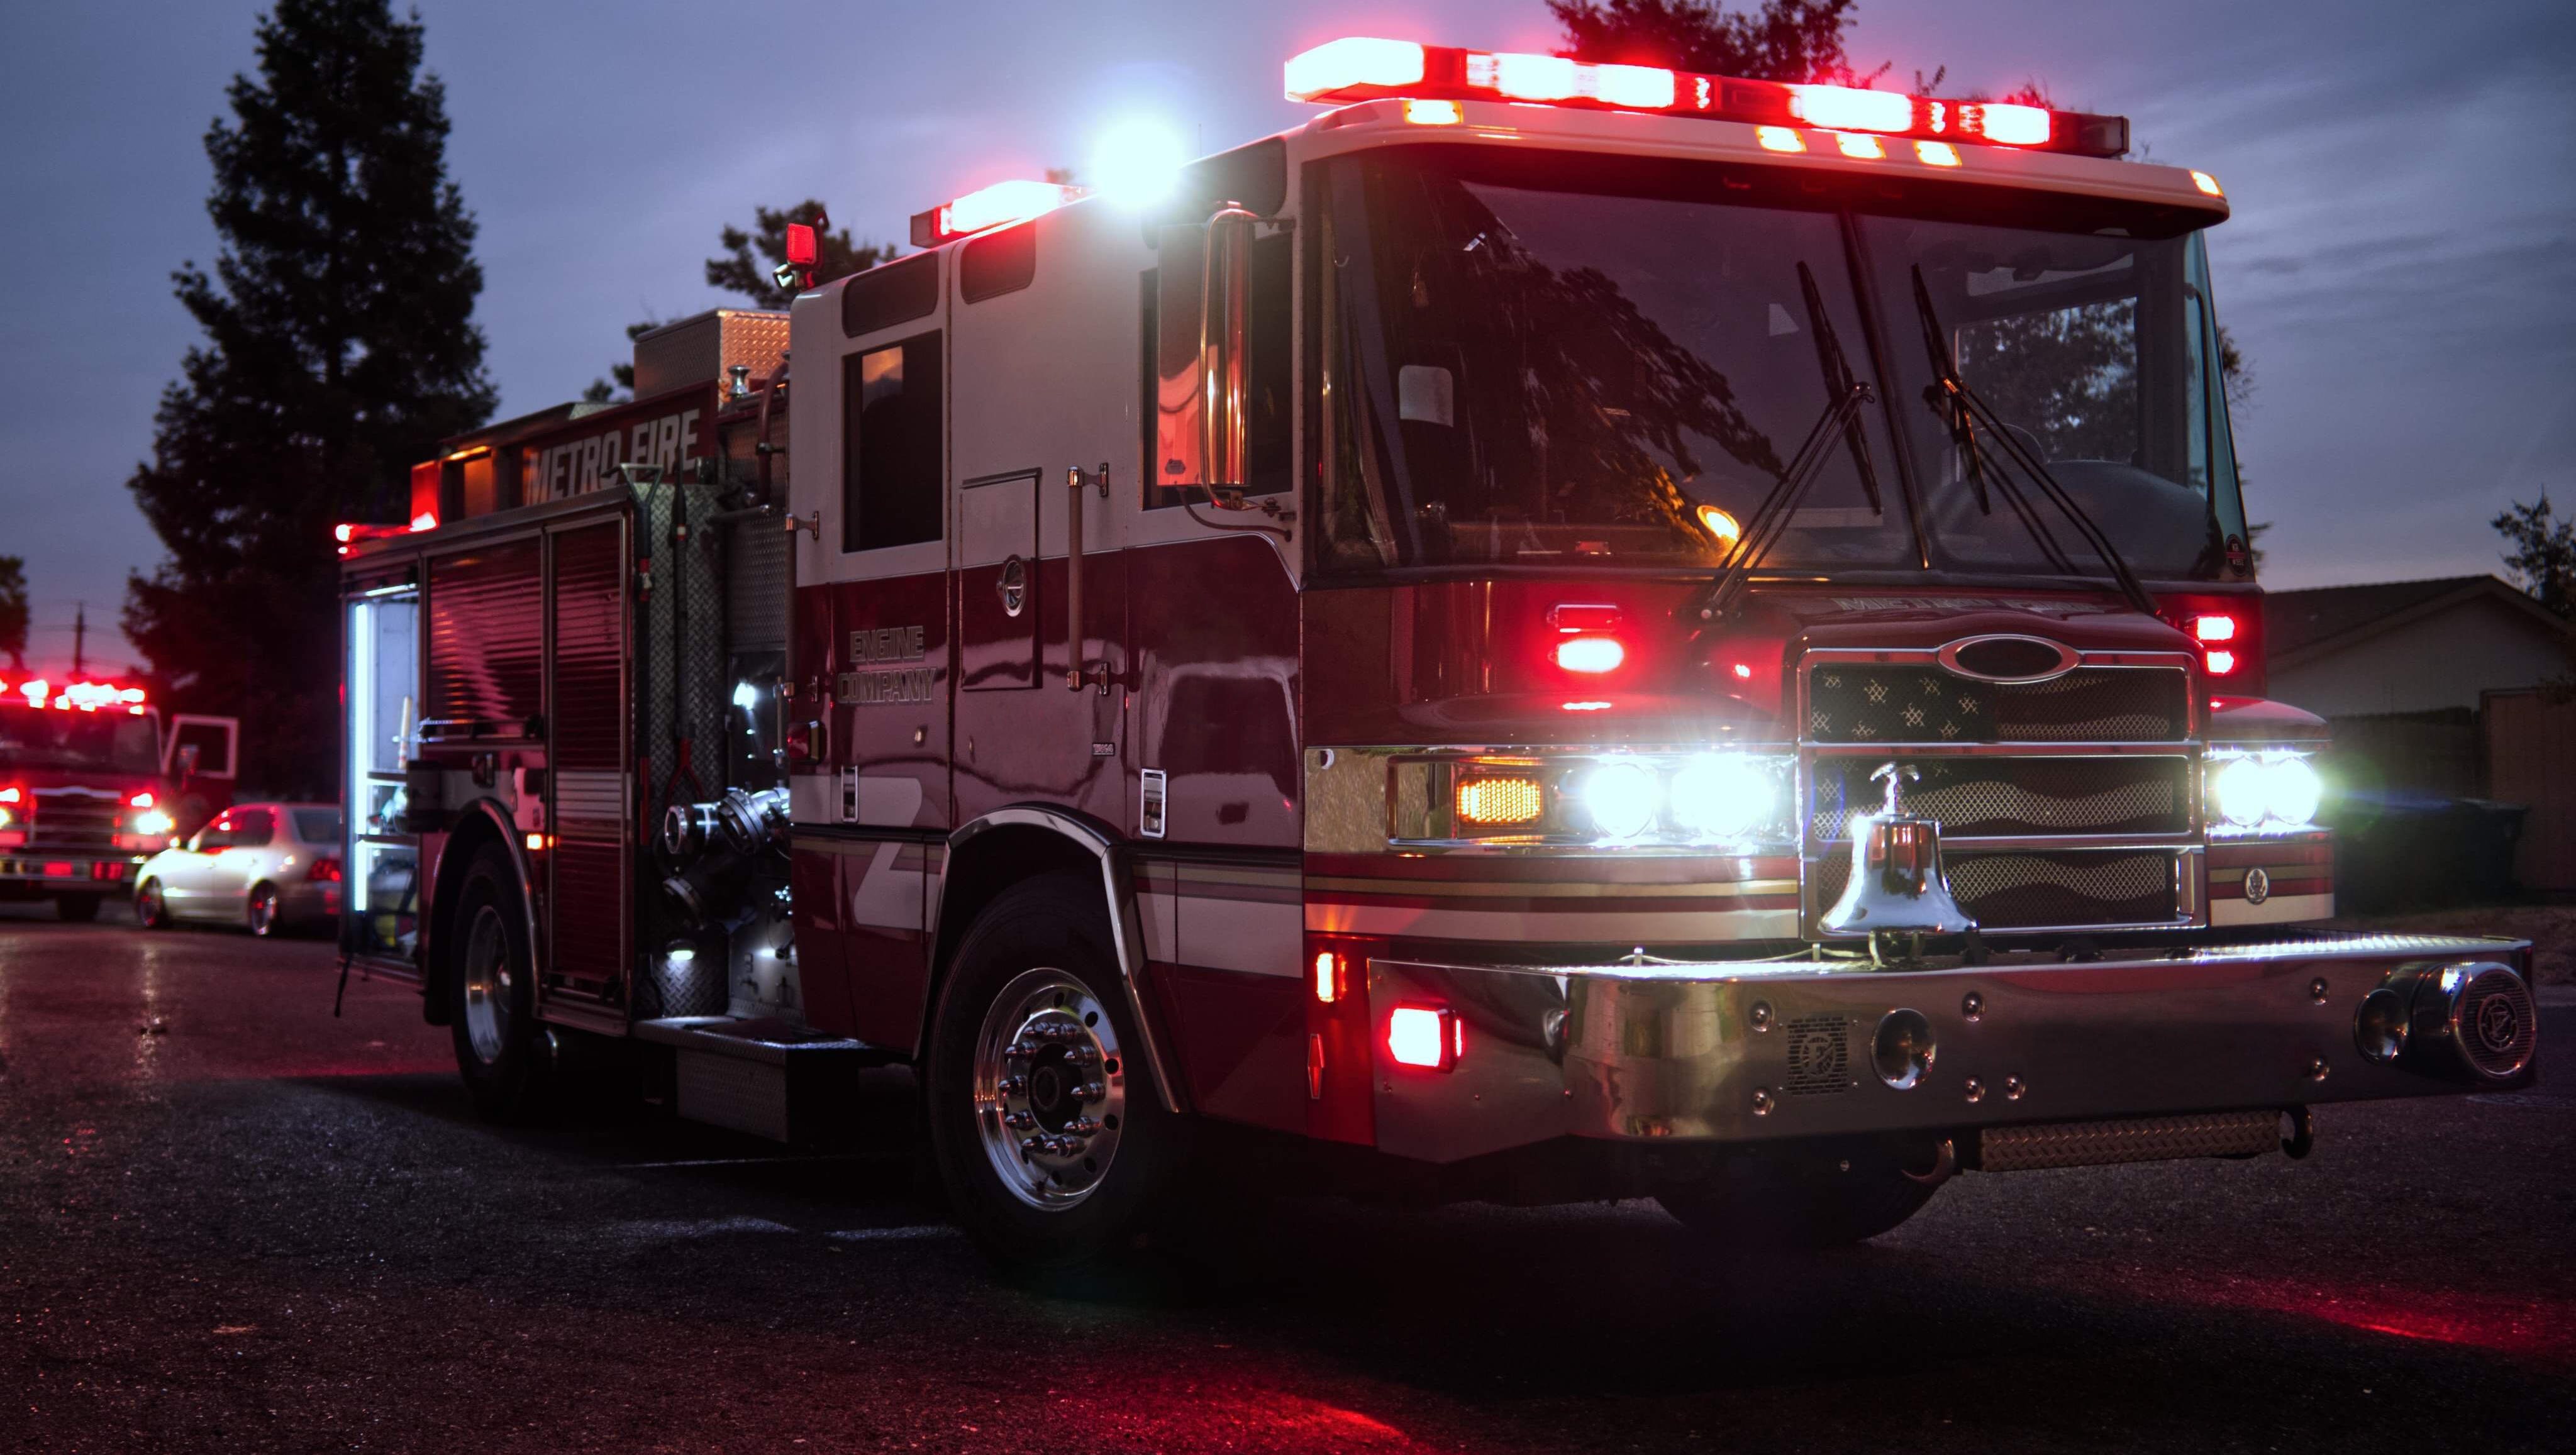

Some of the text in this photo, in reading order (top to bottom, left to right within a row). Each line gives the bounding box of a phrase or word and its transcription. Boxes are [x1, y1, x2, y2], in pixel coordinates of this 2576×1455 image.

[525, 408, 699, 506] METRO FIRE
[850, 626, 925, 662] ENGINE
[837, 668, 936, 704] COMPANY
